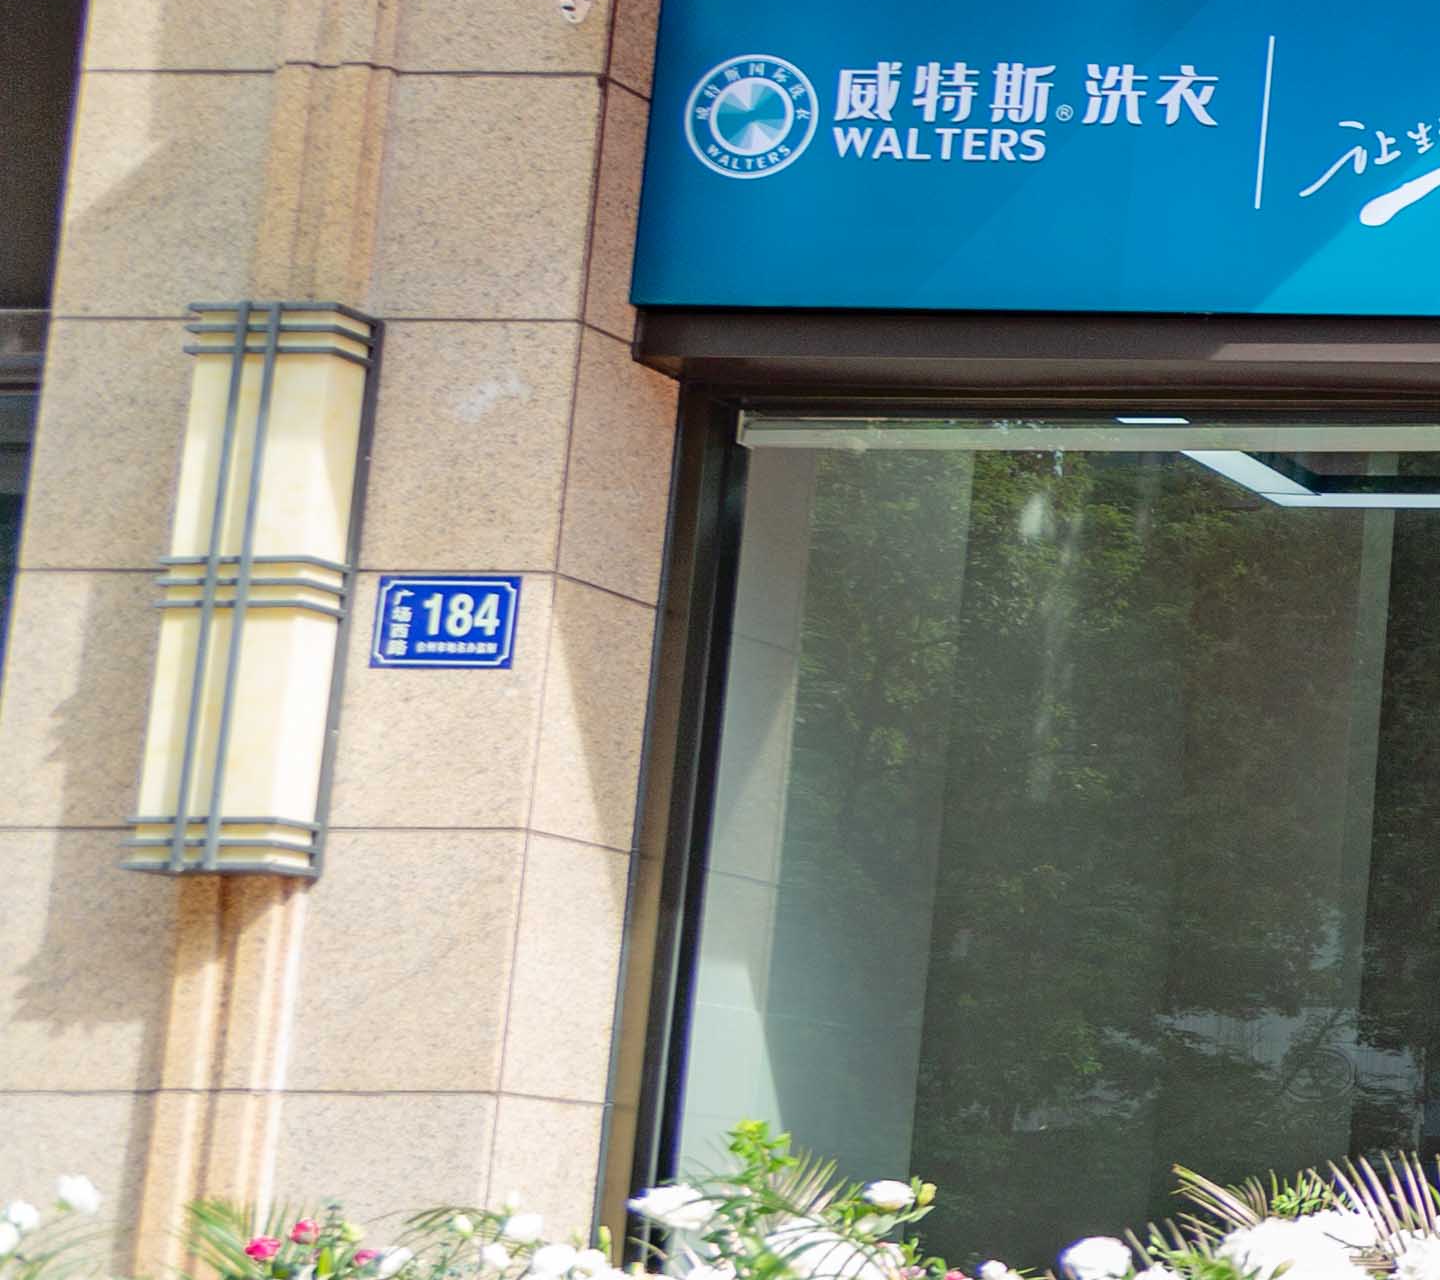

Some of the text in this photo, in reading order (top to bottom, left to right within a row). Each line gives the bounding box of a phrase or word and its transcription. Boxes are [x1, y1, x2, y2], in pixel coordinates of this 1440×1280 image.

[705, 142, 794, 171] WALTERS
[833, 128, 1046, 162] WALTERS
[422, 593, 501, 637] 184
